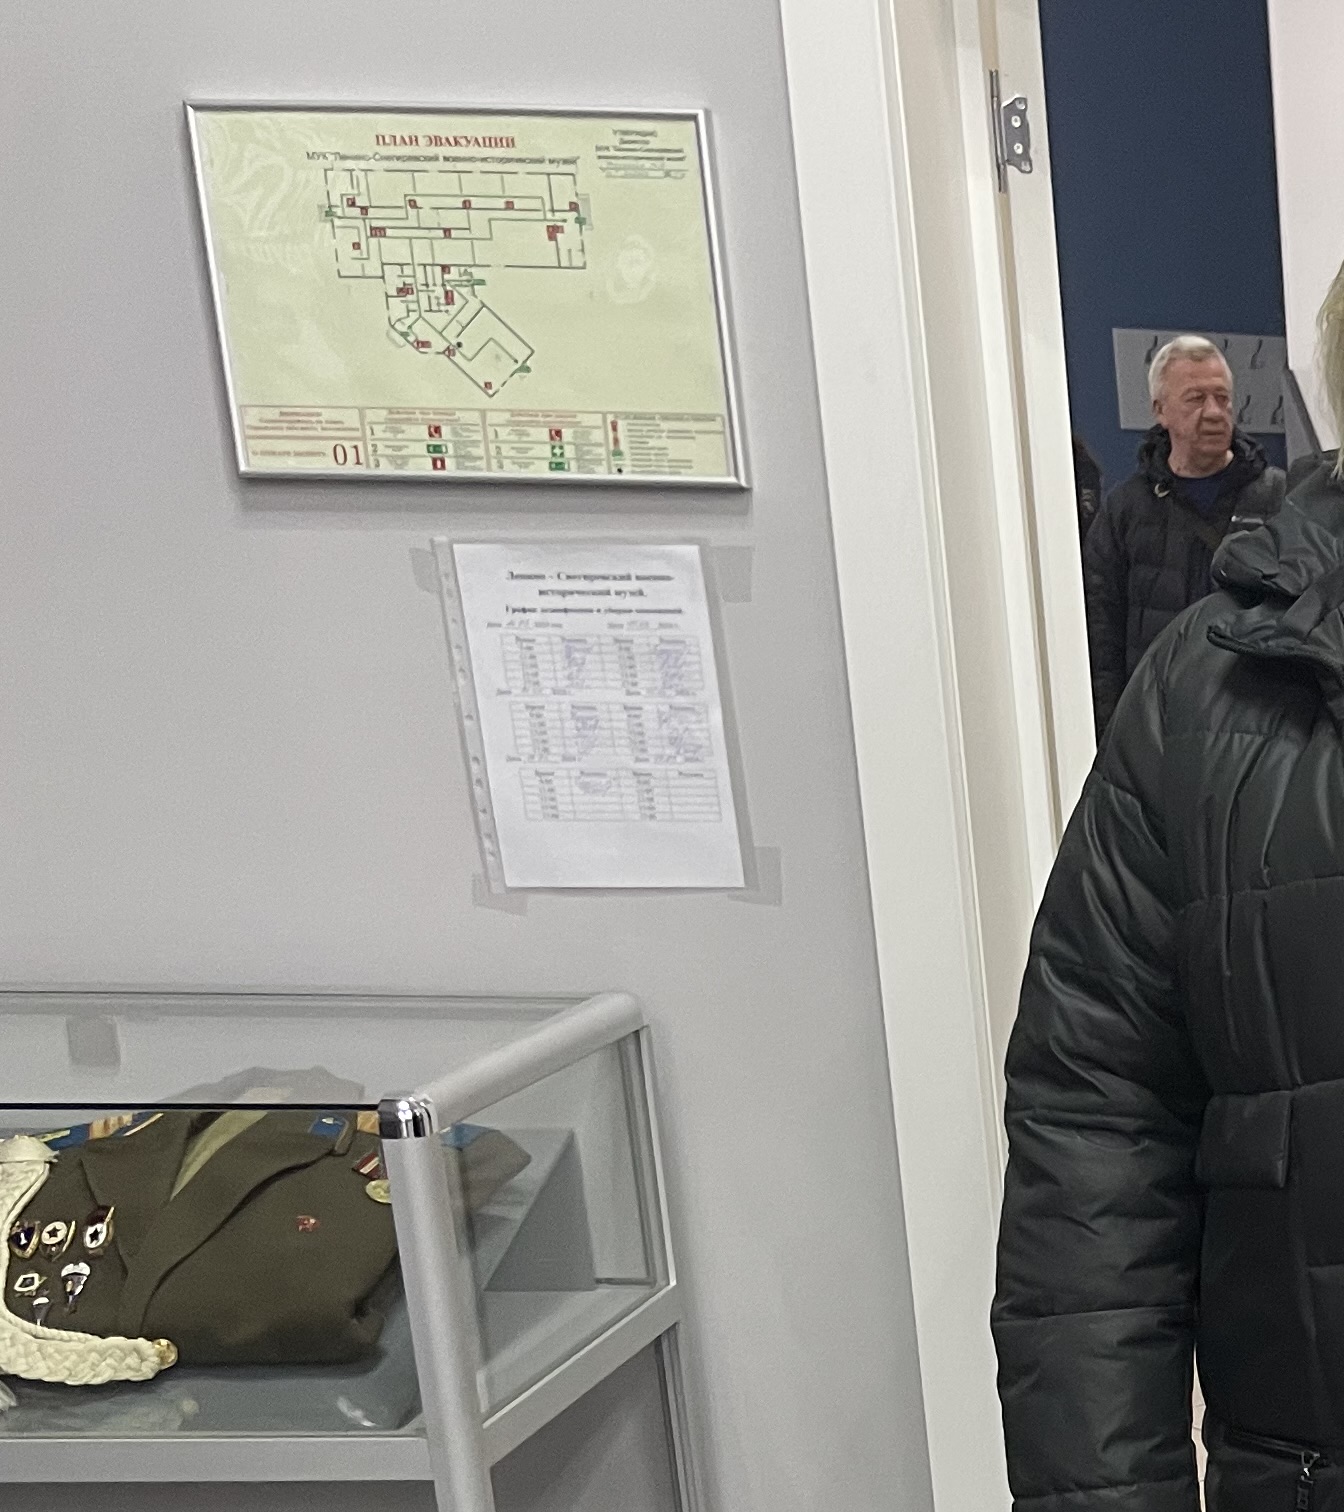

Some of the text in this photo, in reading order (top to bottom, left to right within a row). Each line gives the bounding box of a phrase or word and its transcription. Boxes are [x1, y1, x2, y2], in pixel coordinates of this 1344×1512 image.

[375, 134, 516, 149] ПЛАН ЭВАКУАЦИИ
[333, 443, 363, 466] 01
